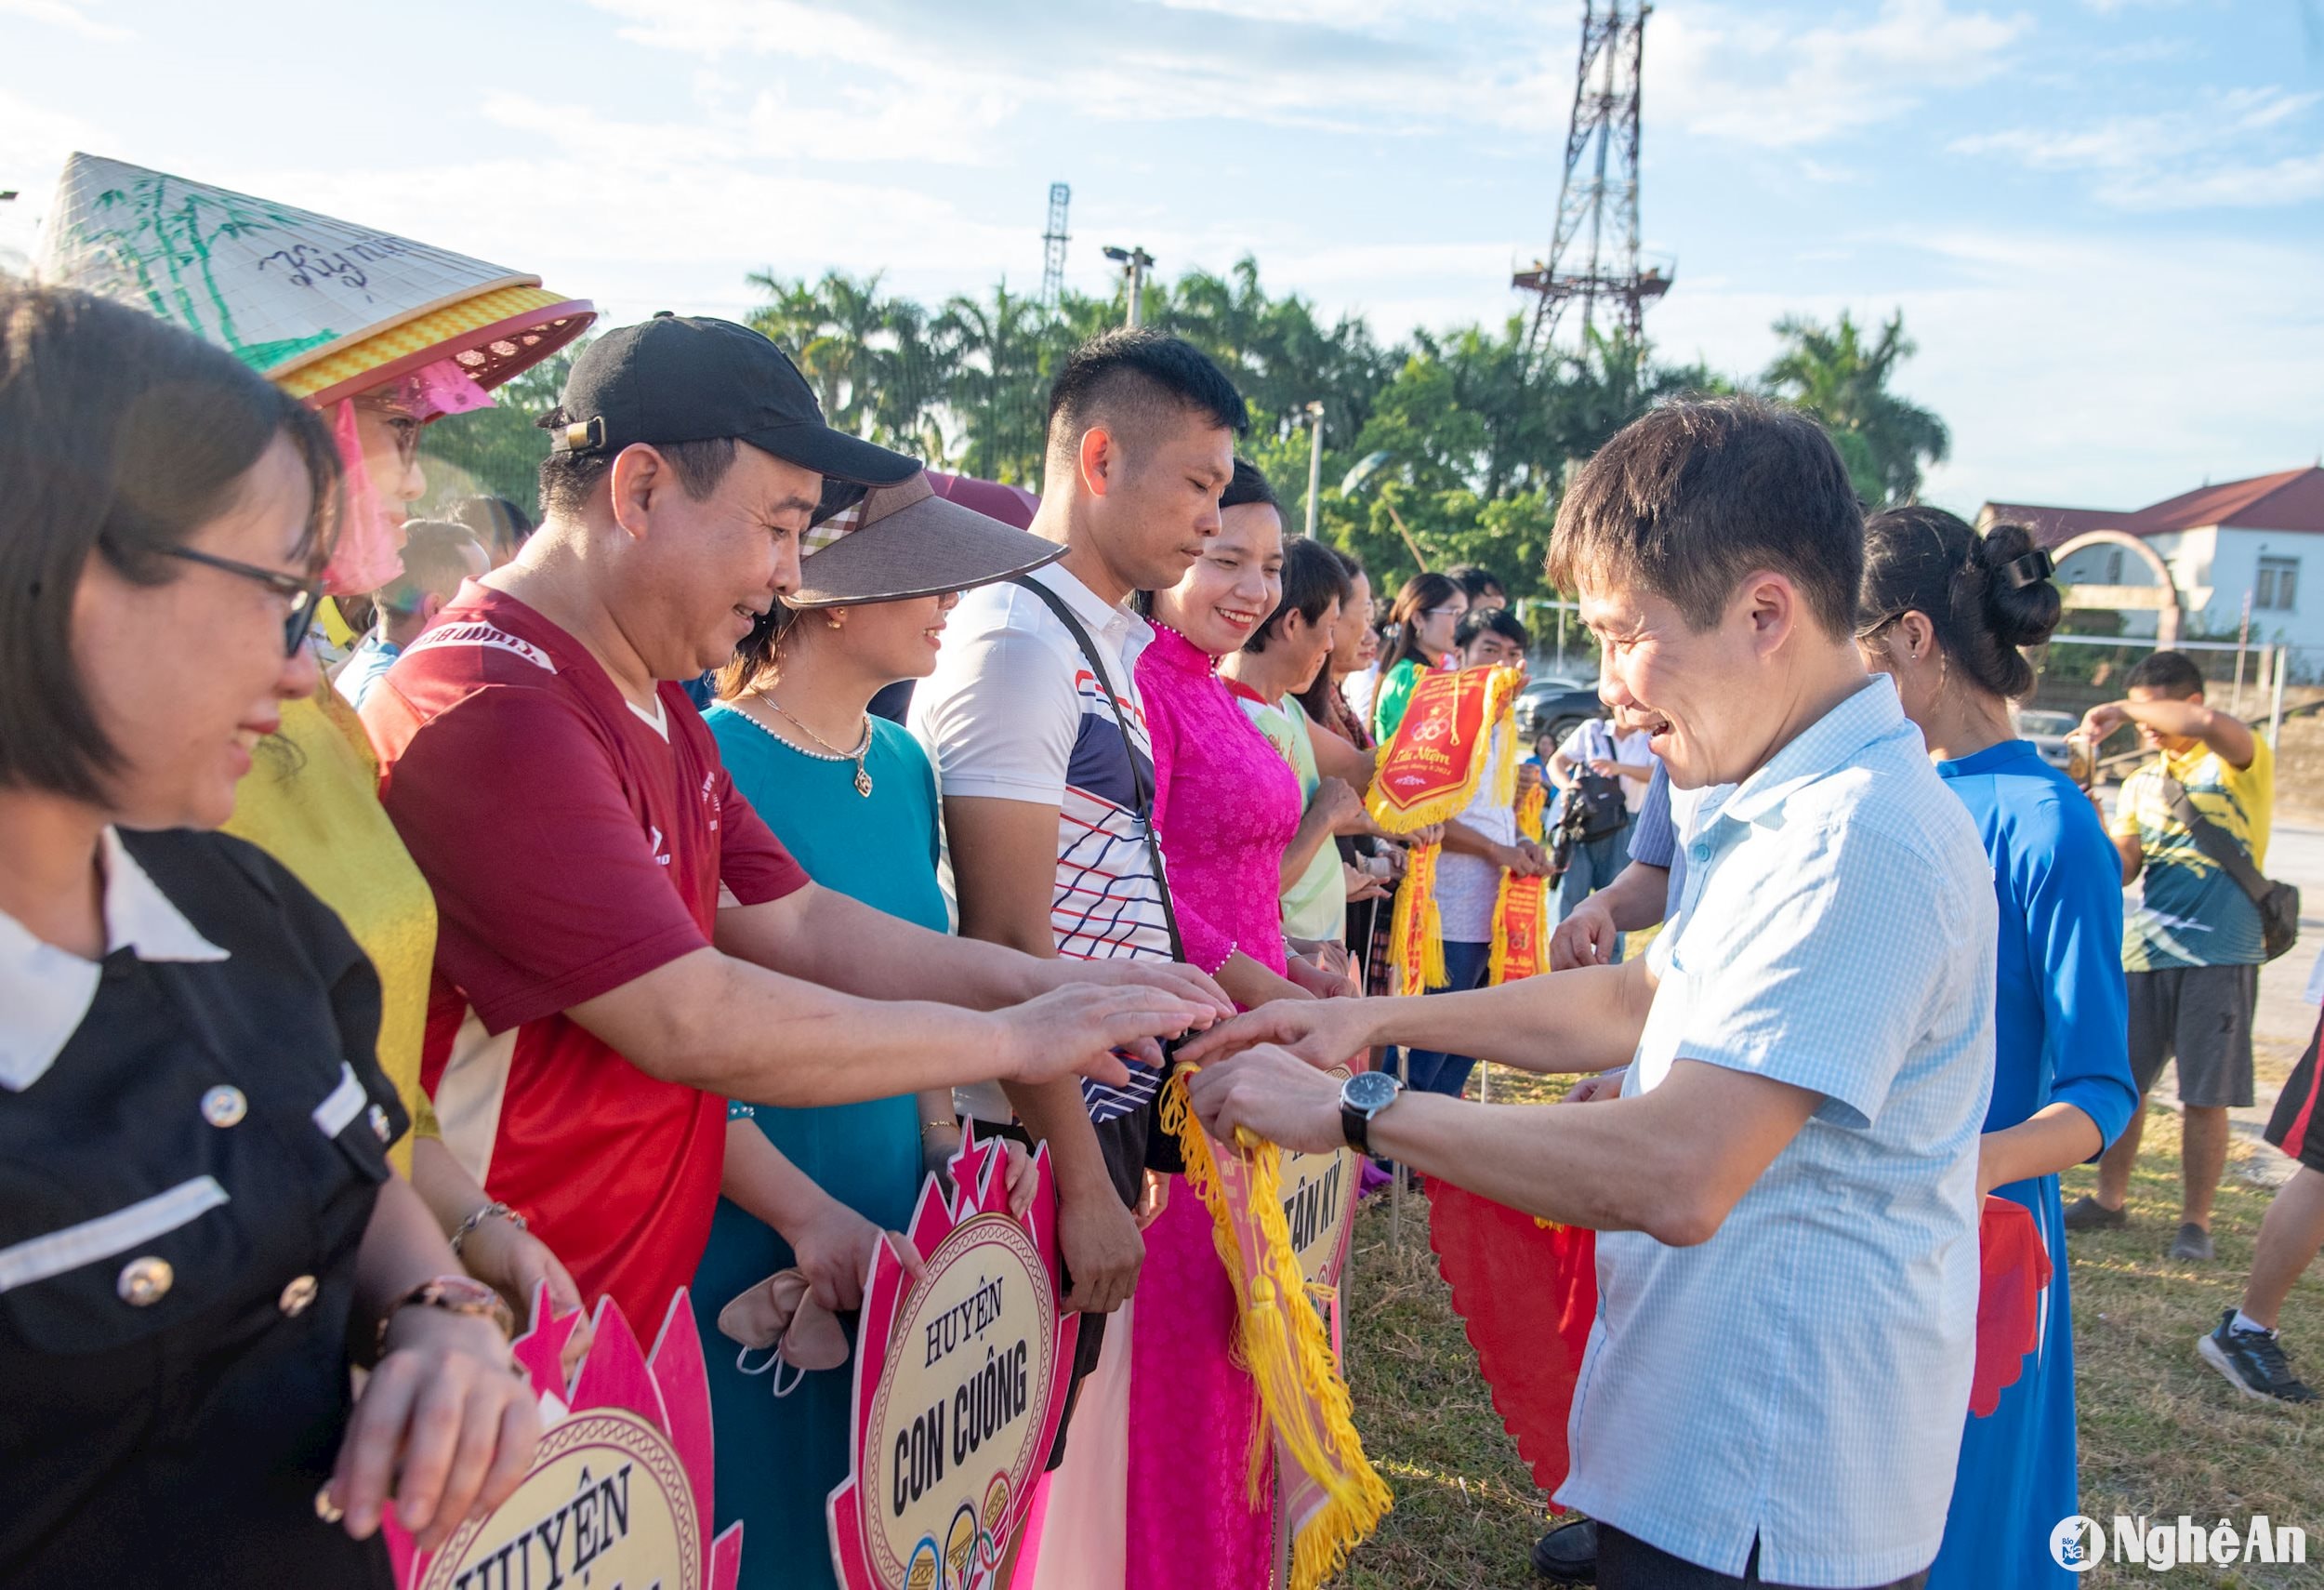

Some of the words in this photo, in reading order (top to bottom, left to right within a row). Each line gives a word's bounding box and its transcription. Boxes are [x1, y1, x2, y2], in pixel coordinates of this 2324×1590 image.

[1414, 746, 1449, 765] Niệm
[925, 1275, 1003, 1369] HUYỆN
[893, 1398, 944, 1517] CON
[953, 1339, 1027, 1466] CUÔNG
[455, 1463, 633, 1590] UYỆN
